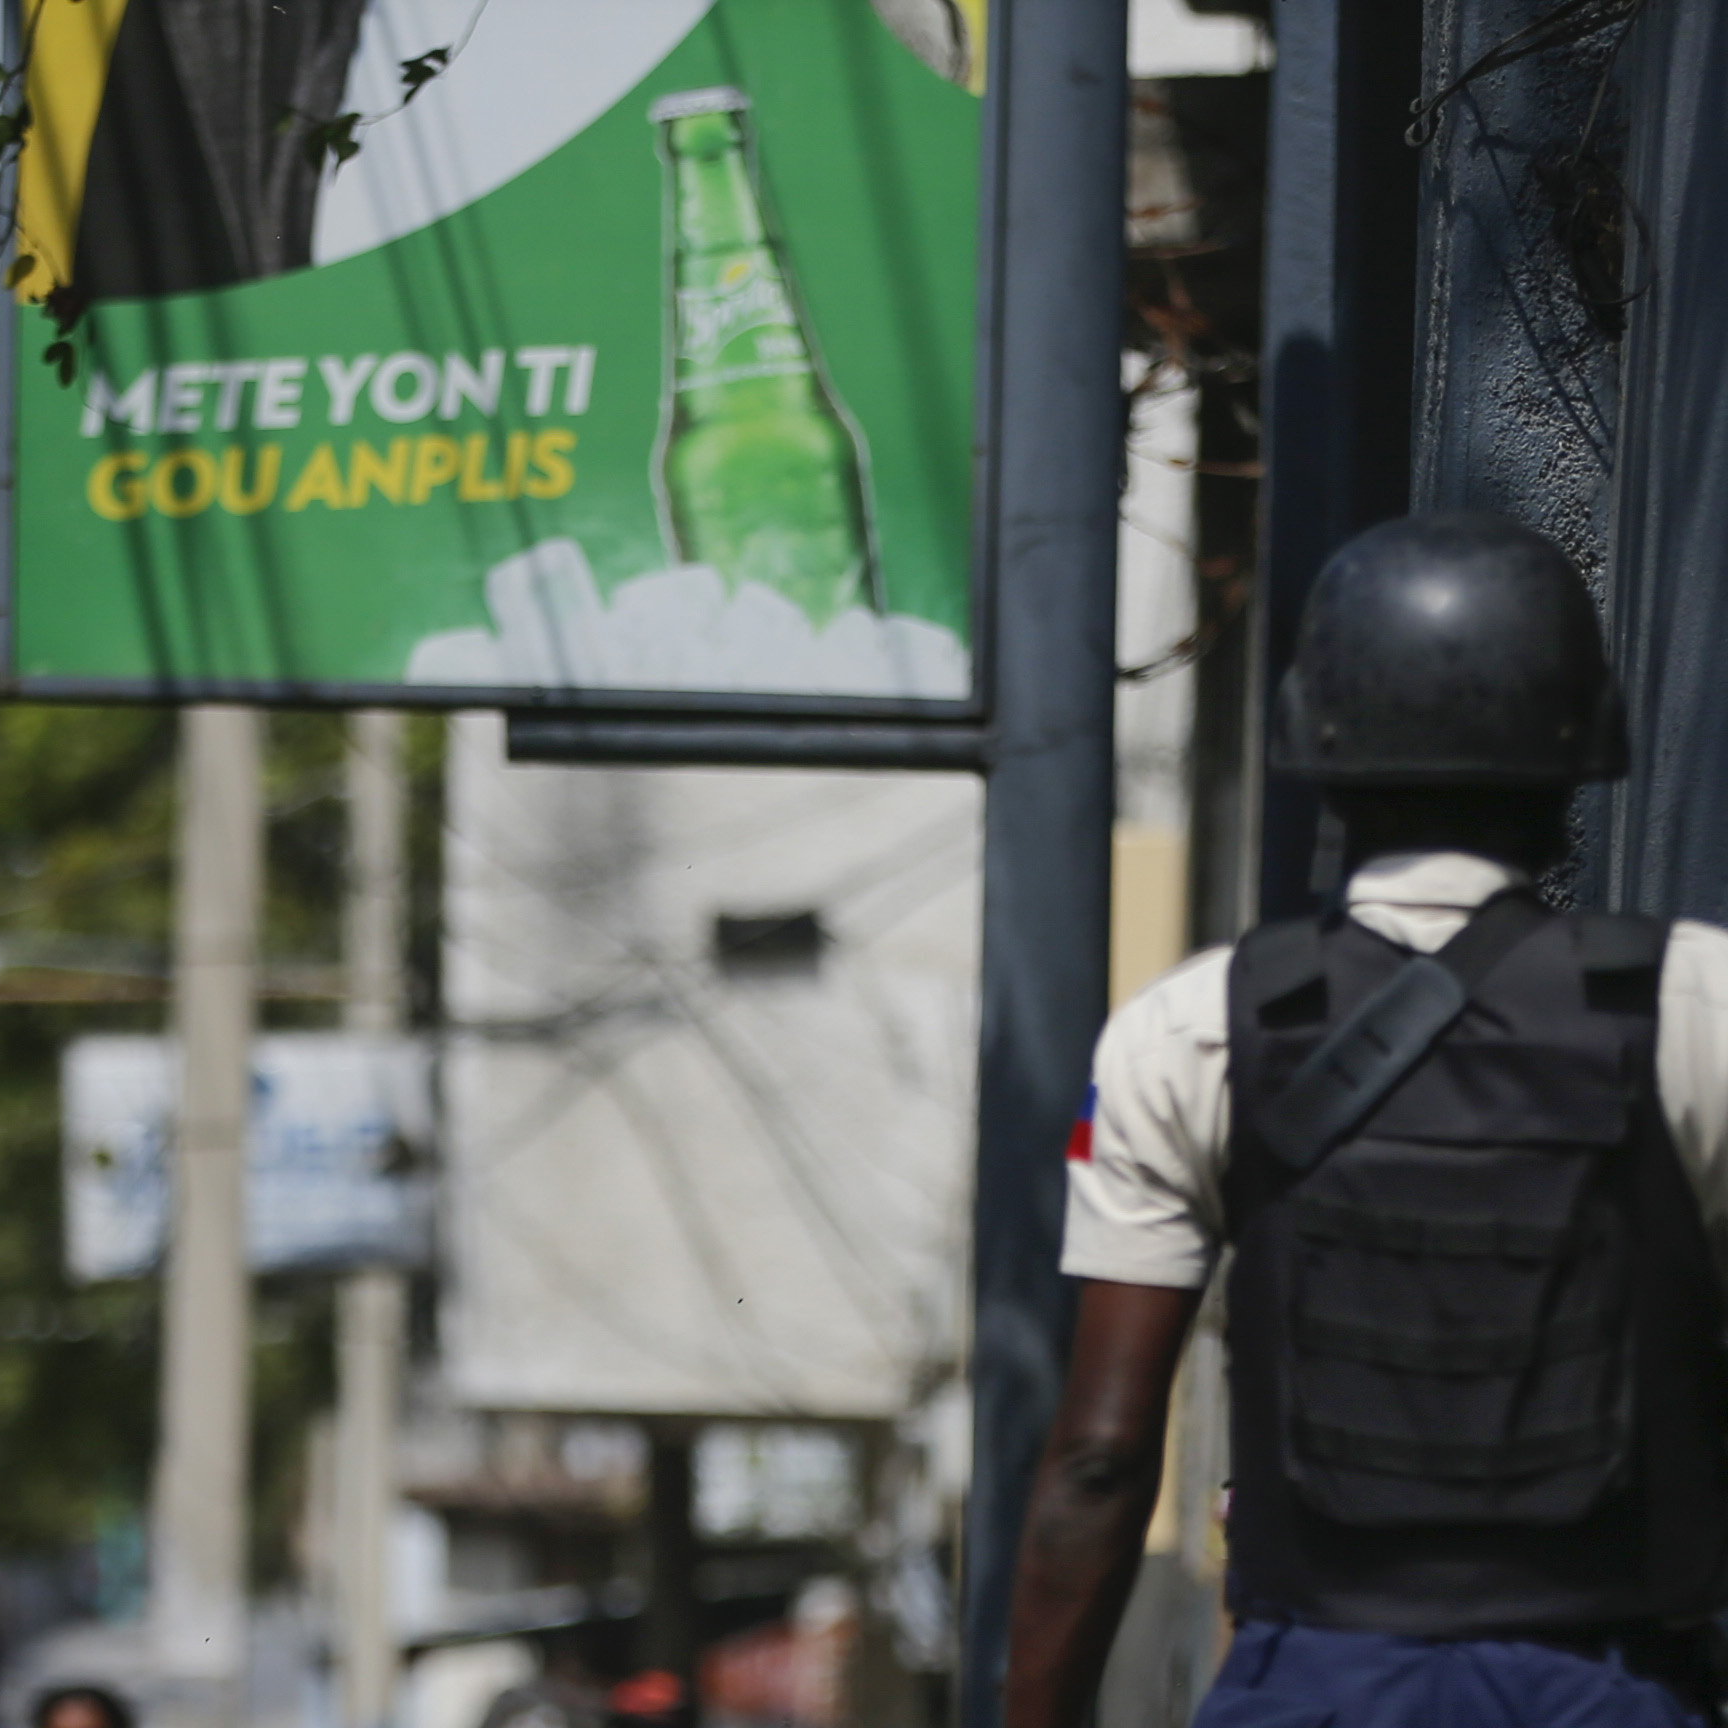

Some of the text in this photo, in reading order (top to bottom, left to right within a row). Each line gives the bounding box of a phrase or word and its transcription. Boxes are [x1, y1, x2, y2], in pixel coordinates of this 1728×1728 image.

[80, 344, 597, 437] METE YON TI
[86, 428, 577, 522] GOU ANPLIS
